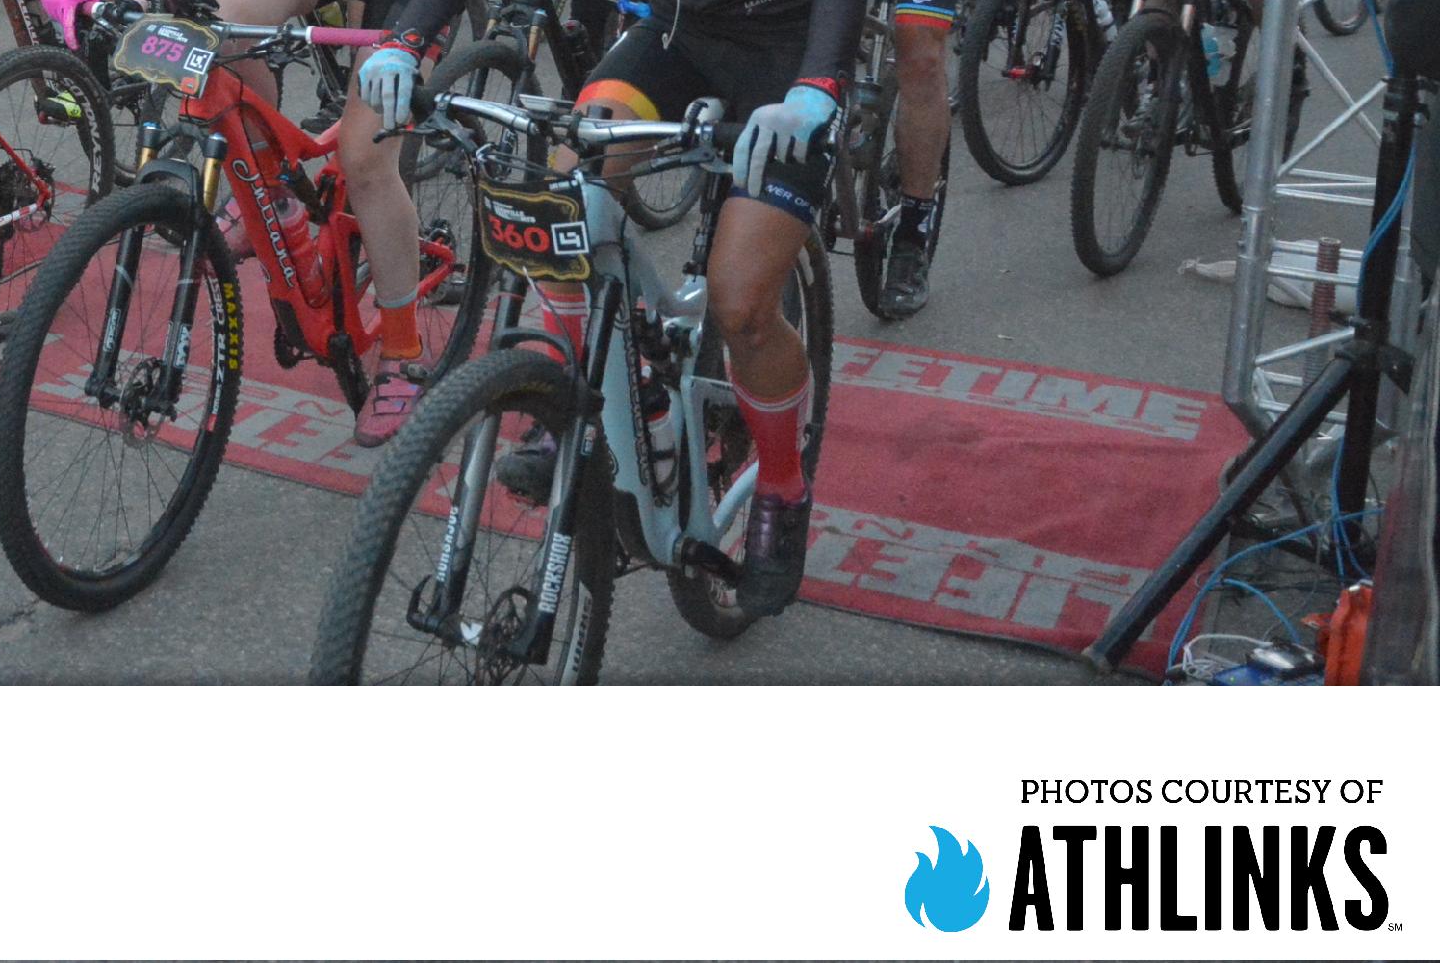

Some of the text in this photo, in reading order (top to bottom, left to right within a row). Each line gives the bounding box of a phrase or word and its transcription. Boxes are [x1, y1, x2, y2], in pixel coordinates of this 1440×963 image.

[141, 35, 187, 63] 875
[231, 158, 295, 289] Juliana
[487, 212, 551, 254] 360
[213, 277, 228, 326] CREST
[221, 281, 240, 371] MAXXIS
[211, 329, 227, 383] ZTR
[538, 532, 572, 614] ROCKSHOX
